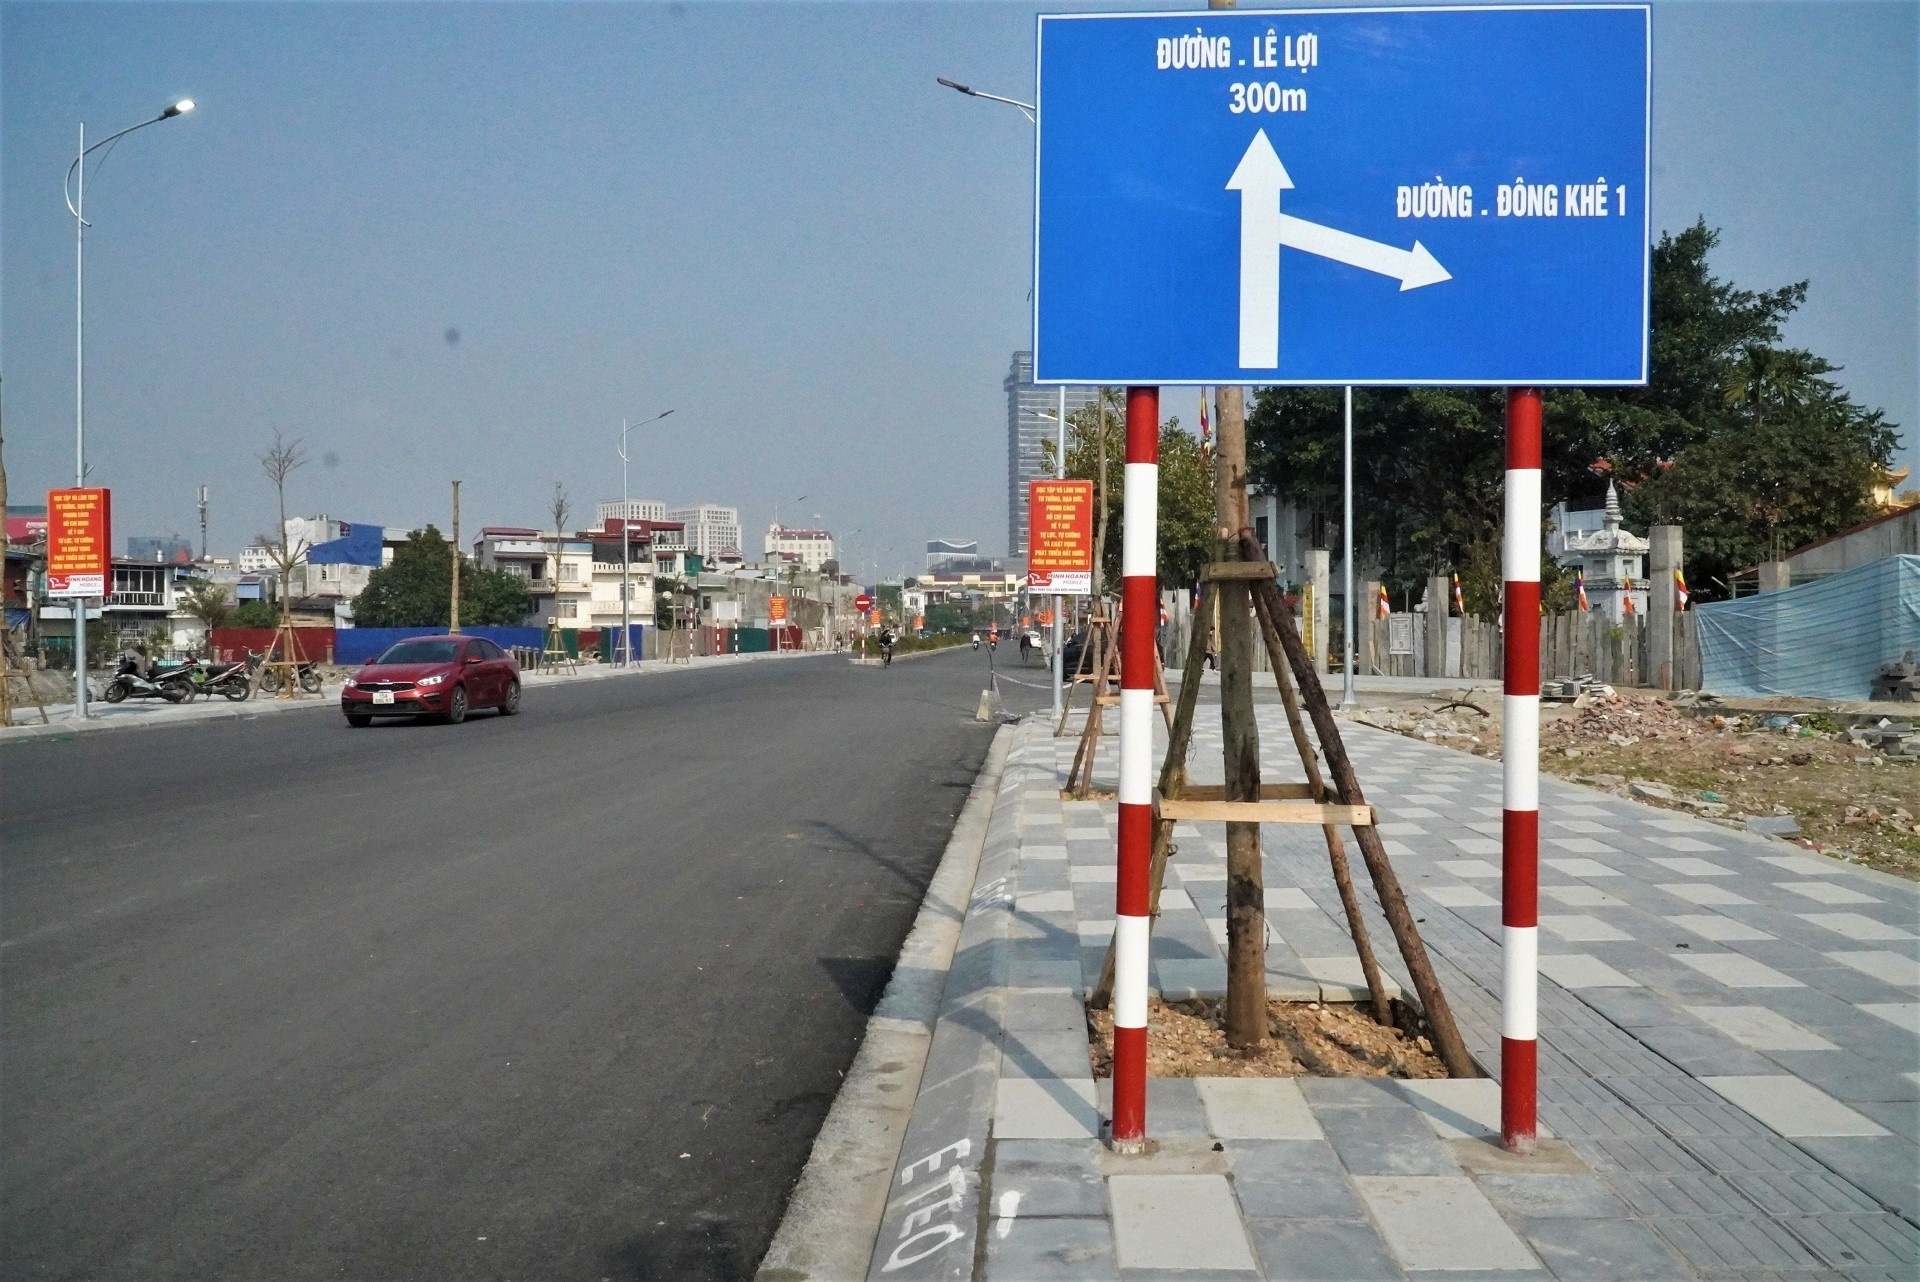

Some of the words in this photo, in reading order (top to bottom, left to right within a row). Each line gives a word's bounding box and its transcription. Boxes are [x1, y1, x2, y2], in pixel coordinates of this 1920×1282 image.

[1157, 28, 1231, 69] ĐƯỜNG
[1253, 28, 1278, 67] LÊ
[1284, 32, 1318, 74] LỢI
[1229, 81, 1307, 114] 300m
[1396, 175, 1473, 218] ĐƯỜNG
[1496, 176, 1558, 217] ĐÔNG
[1565, 176, 1608, 217] KHÊ
[1615, 184, 1626, 216] 1
